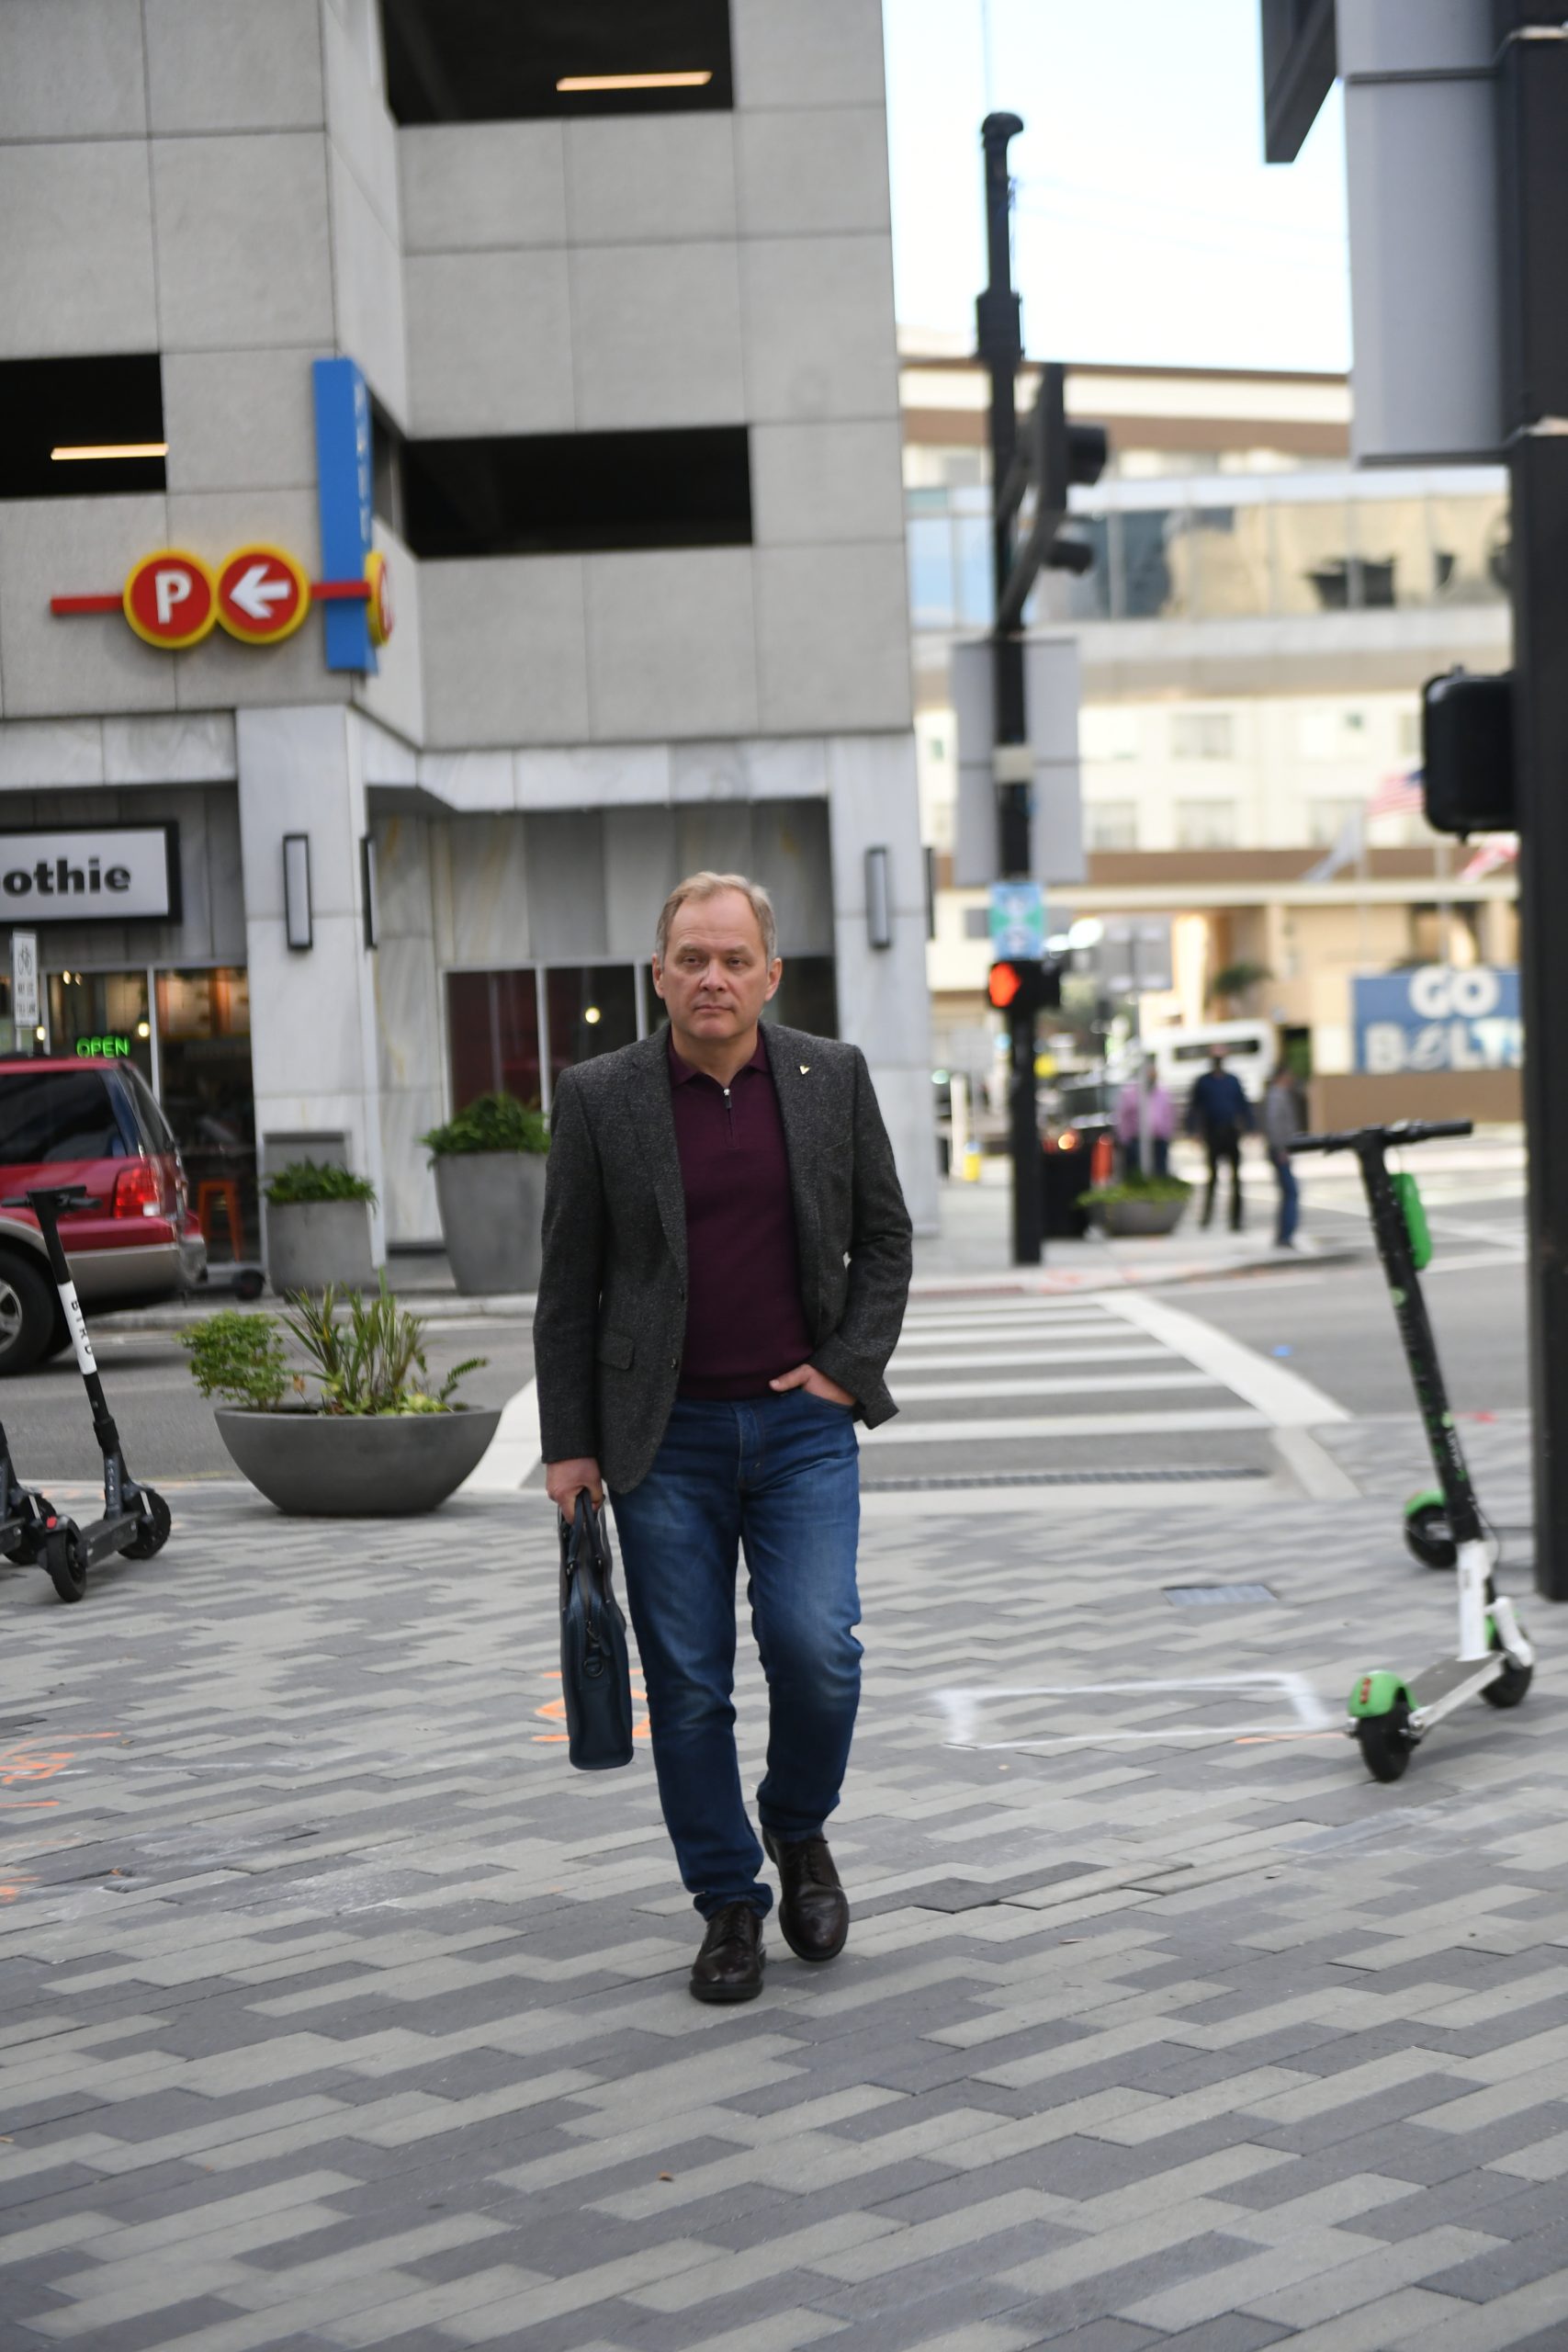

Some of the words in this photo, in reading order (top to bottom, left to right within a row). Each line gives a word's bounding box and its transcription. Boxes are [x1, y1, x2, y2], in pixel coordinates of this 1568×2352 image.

[154, 570, 192, 624] P
[3, 856, 131, 898] othie
[1409, 965, 1499, 1018] GO
[76, 1036, 130, 1058] OPEN
[71, 1300, 93, 1355] BIRD
